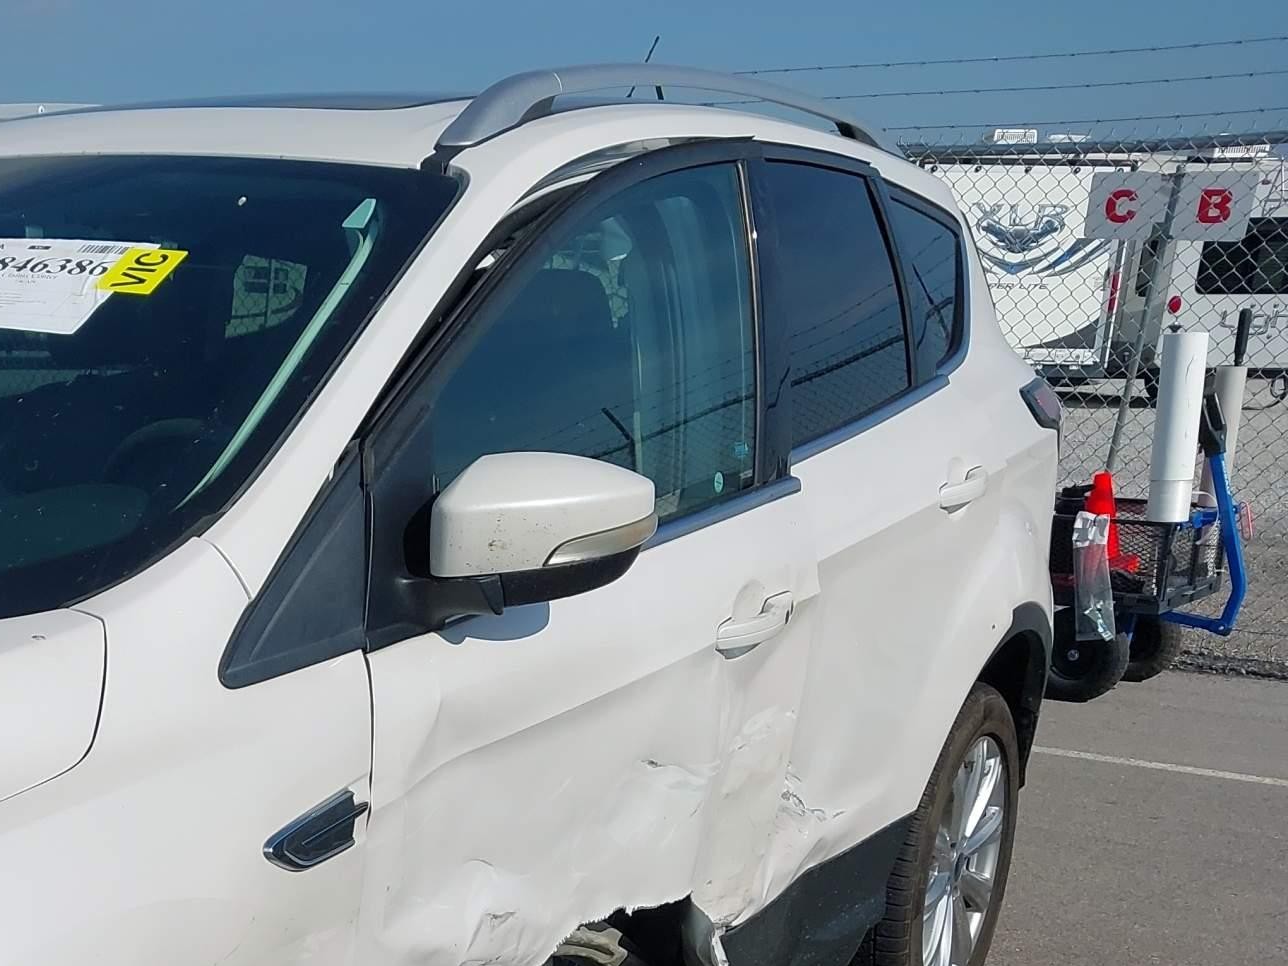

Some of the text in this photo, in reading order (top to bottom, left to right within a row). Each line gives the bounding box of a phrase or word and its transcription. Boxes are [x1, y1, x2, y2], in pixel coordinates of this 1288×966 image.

[1105, 188, 1138, 224] C
[1196, 188, 1232, 224] B
[110, 252, 169, 288] VIC
[1018, 282, 1049, 290] LITE
